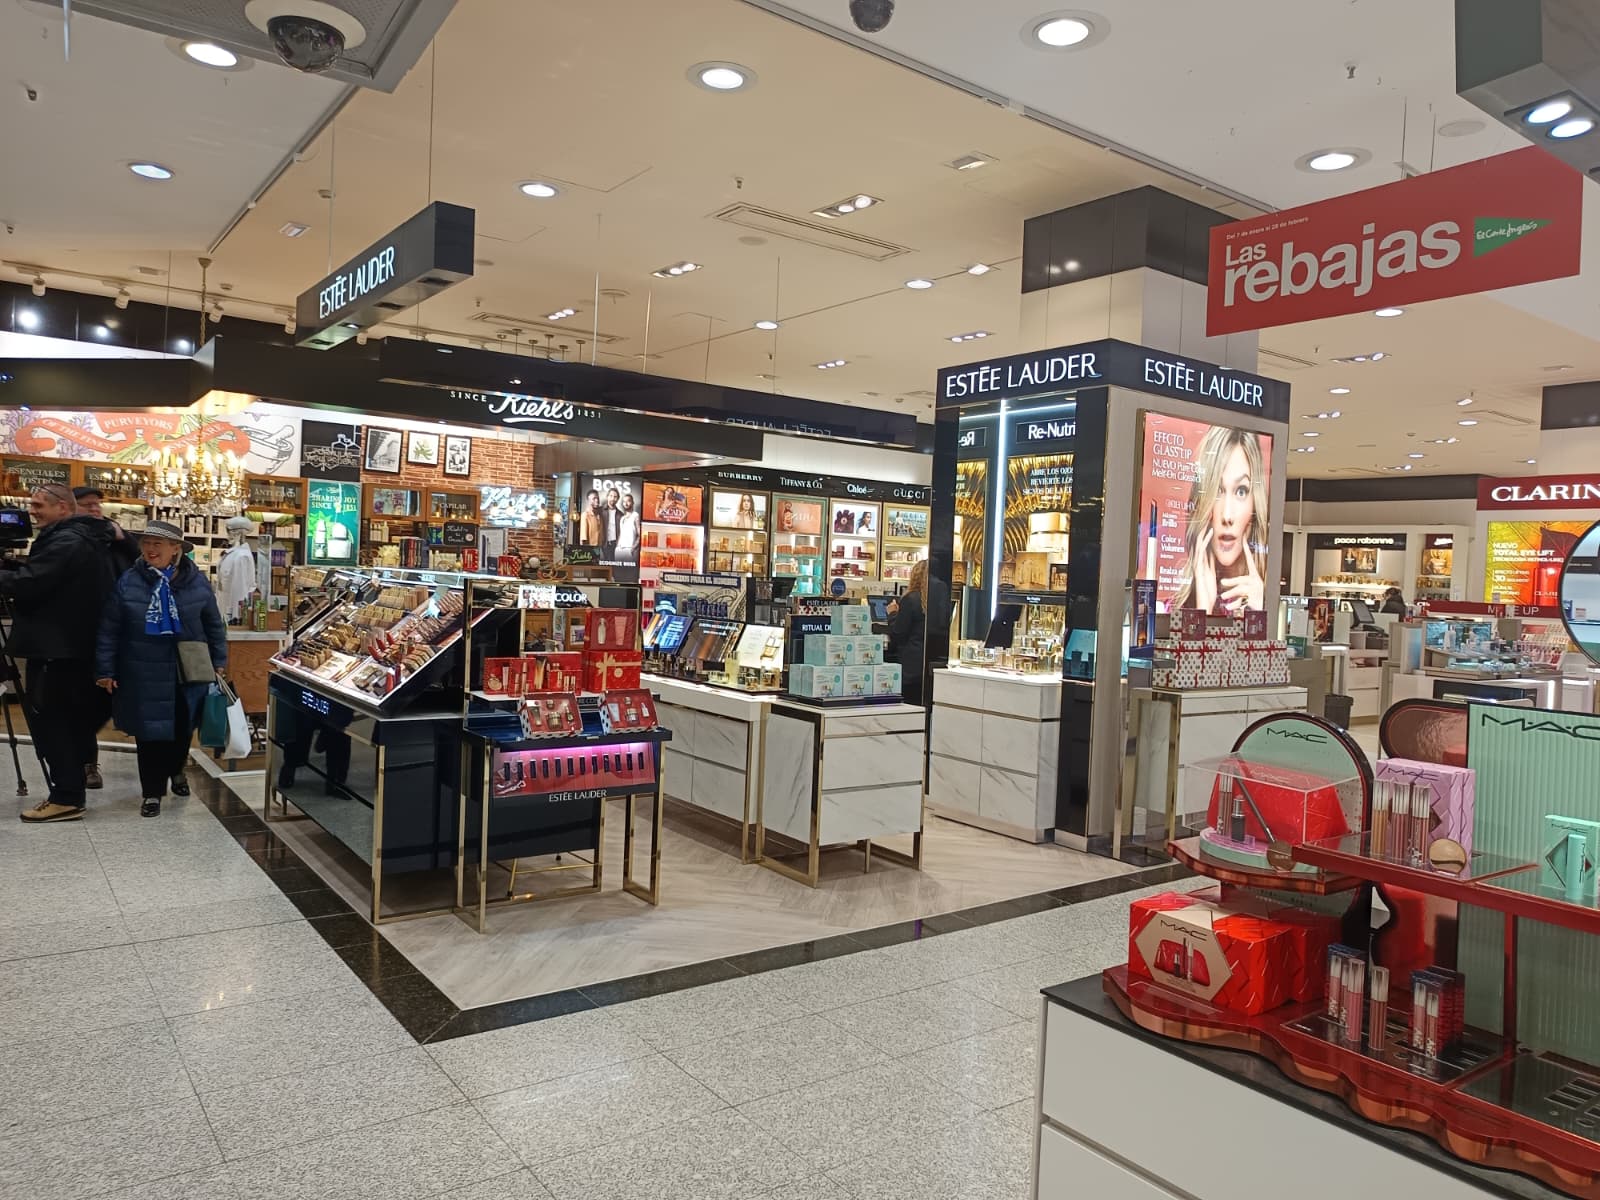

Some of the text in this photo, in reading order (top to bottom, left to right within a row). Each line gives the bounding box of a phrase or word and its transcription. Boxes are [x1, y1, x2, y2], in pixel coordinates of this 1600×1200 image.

[1249, 227, 1265, 235] enero
[1288, 216, 1309, 226] febrero
[1476, 230, 1486, 240] El
[1486, 229, 1506, 238] Corte
[1225, 241, 1266, 266] Las
[1224, 221, 1462, 307] rebajas
[349, 246, 395, 301] LAUDER
[1007, 353, 1096, 388] LAUDER
[1200, 371, 1263, 407] LAUDER
[450, 390, 487, 402] SINCE
[488, 395, 574, 421] Kiehl's
[104, 416, 173, 431] PURVEYORS
[1153, 431, 1185, 446] EFECTO
[1152, 458, 1177, 470] NUEVO
[8, 467, 66, 478] ESENCIALES
[718, 471, 764, 482] BURBERRY
[1030, 468, 1047, 476] ABRE
[1047, 467, 1059, 475] LOS
[592, 478, 632, 494] BOSS
[780, 476, 806, 487] TIFFANY
[847, 483, 868, 494] Chloé
[893, 488, 925, 499] GUCCI
[344, 496, 357, 504] JOY
[1161, 534, 1177, 544] Color
[1334, 536, 1394, 545] paco rabanne
[555, 592, 588, 603] COLOR
[1523, 606, 1540, 615] UP
[802, 624, 823, 632] RITUAL
[574, 789, 608, 800] LAUDER
